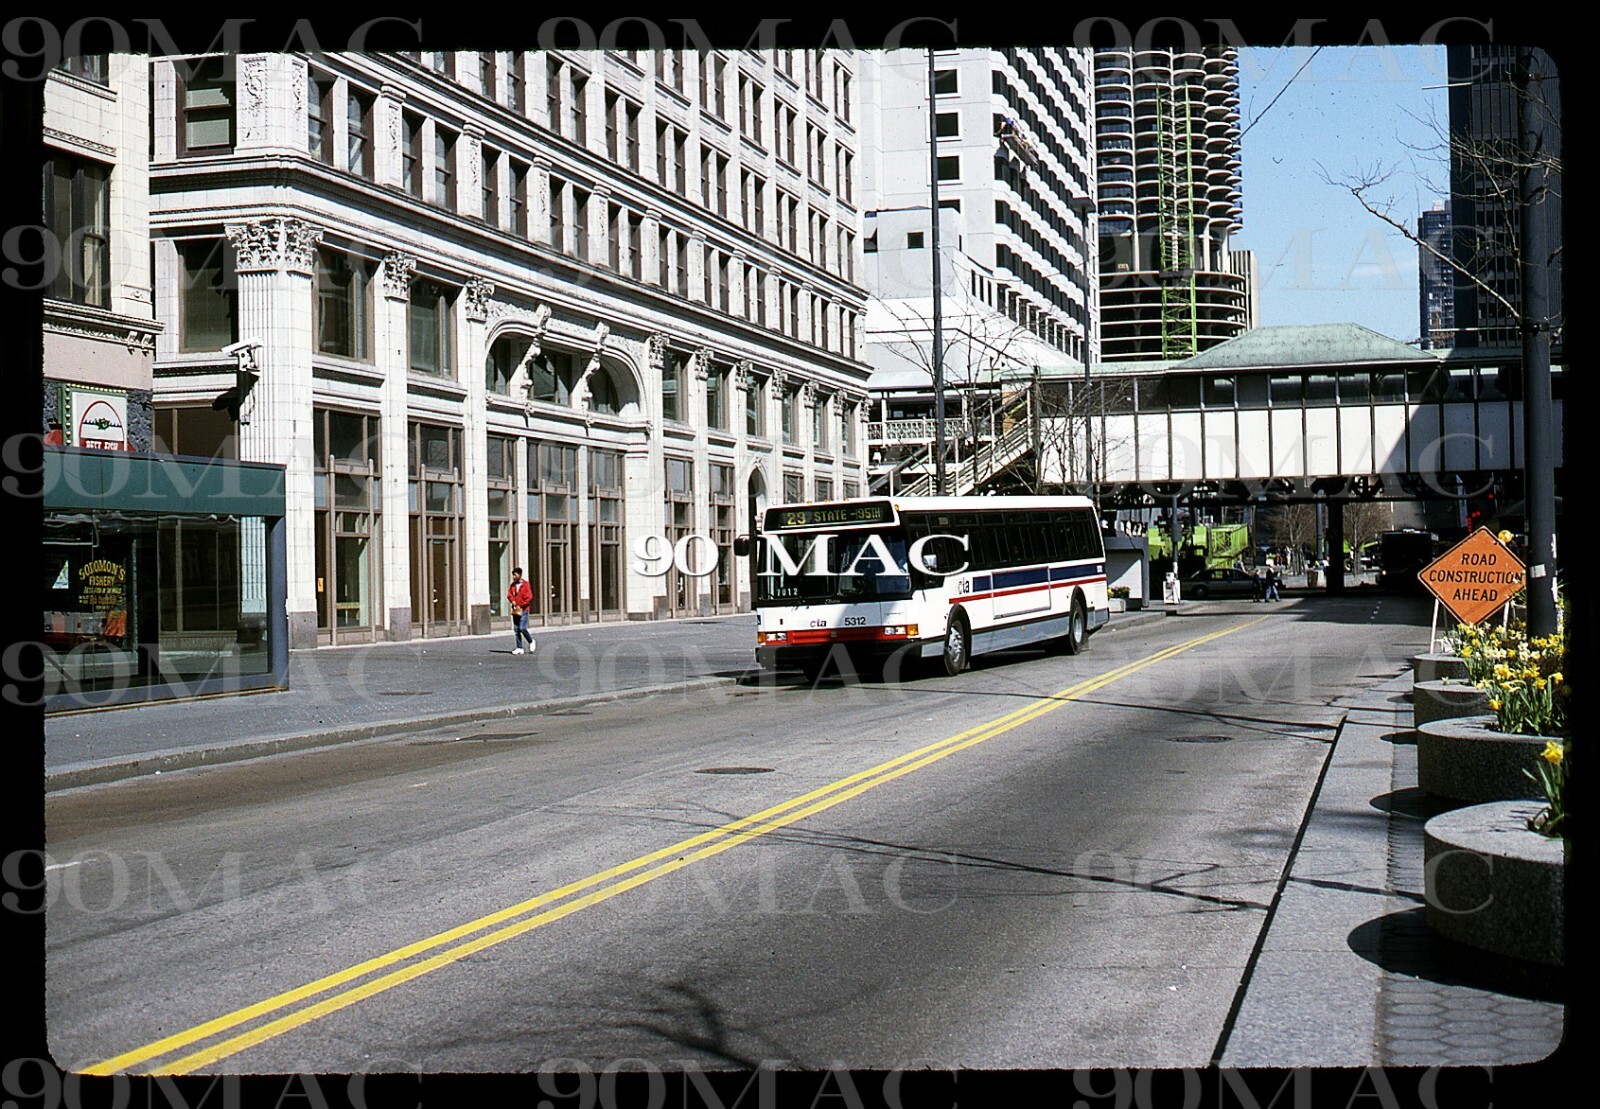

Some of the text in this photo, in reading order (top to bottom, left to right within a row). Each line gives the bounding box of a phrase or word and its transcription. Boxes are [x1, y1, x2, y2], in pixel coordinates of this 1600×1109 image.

[787, 512, 806, 525] 29
[814, 509, 847, 522] STATE
[1461, 553, 1497, 566] ROAD
[1429, 570, 1524, 585] CONSTRUCTION
[1453, 588, 1498, 602] AHEAD
[844, 616, 867, 627] 5312
